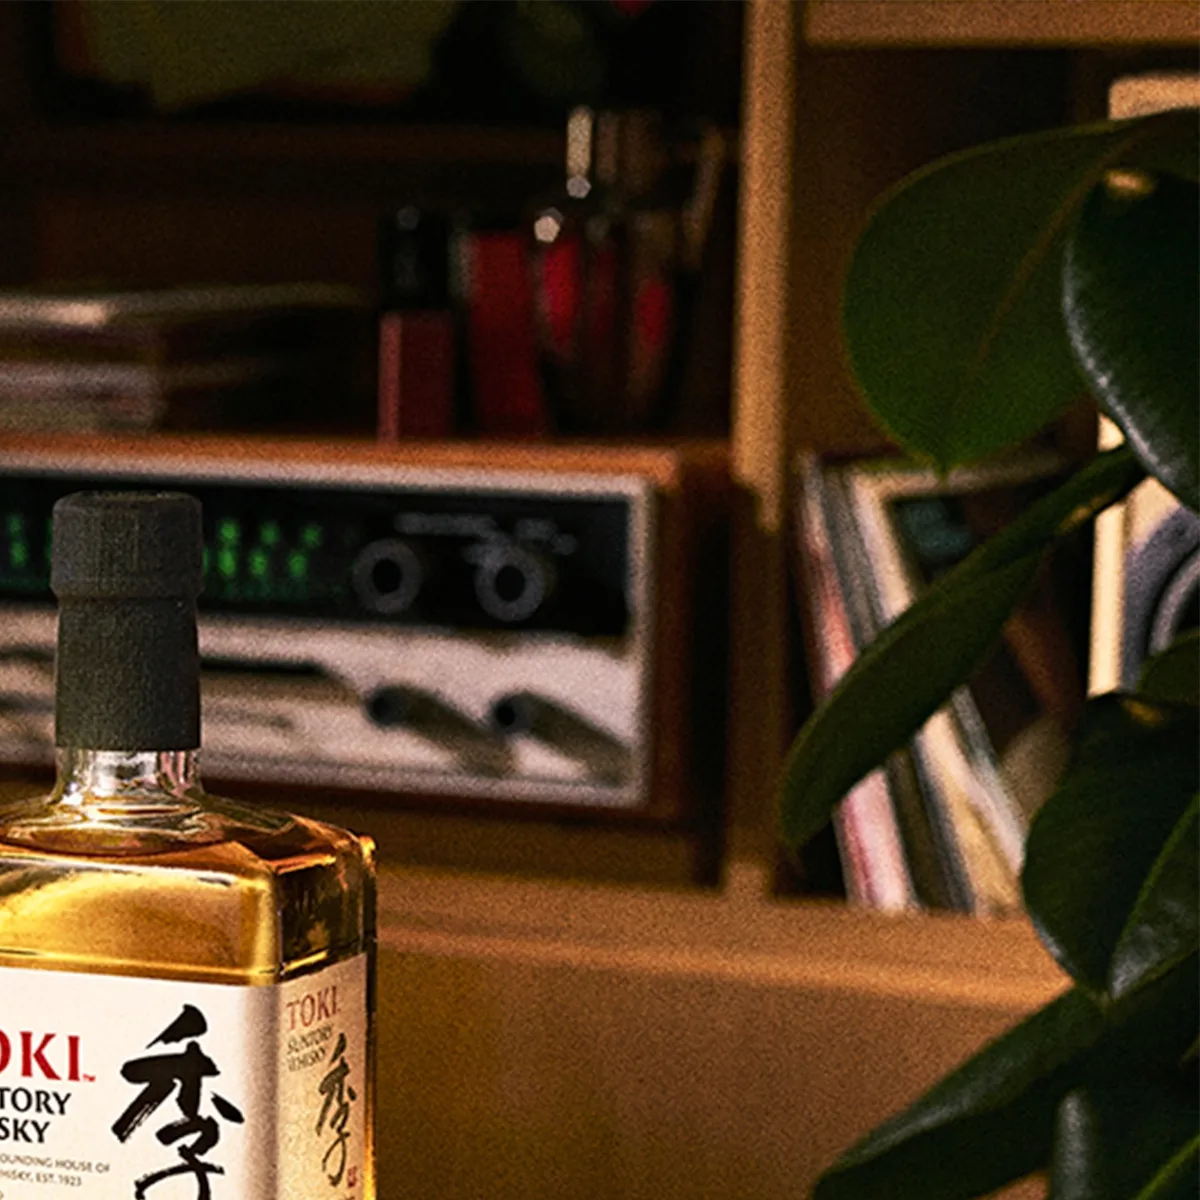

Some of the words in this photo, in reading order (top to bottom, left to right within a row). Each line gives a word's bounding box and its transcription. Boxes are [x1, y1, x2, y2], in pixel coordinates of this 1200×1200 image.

[287, 985, 337, 1030] TOKI
[315, 1032, 357, 1187] 季
[55, 1159, 92, 1172] HOUSE
[95, 1162, 110, 1173] OF
[59, 1175, 83, 1187] 1923
